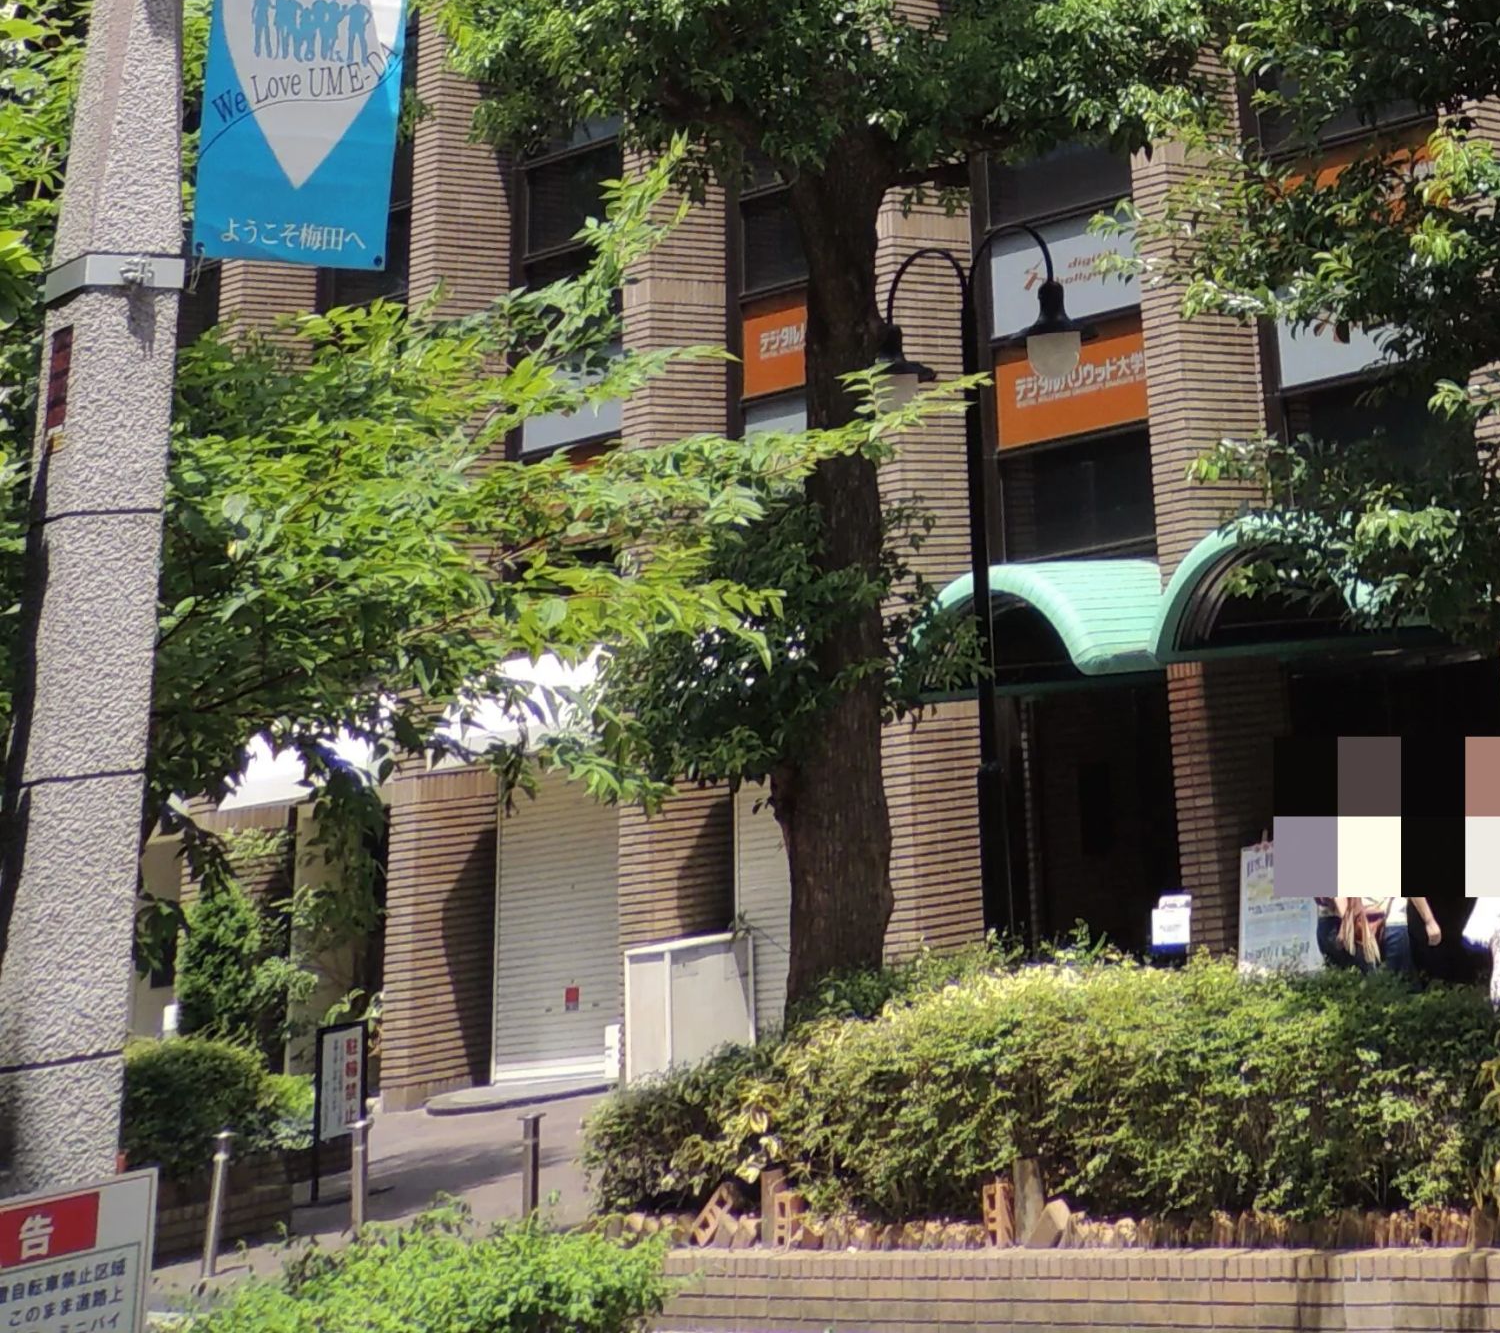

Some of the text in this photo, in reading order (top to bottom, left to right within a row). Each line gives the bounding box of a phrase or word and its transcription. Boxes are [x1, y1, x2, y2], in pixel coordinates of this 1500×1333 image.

[211, 41, 399, 123] We Love UME-DA
[220, 217, 367, 252] ようこそ梅田へ
[18, 1213, 55, 1261] 告
[8, 1285, 124, 1327] このまま道路上
